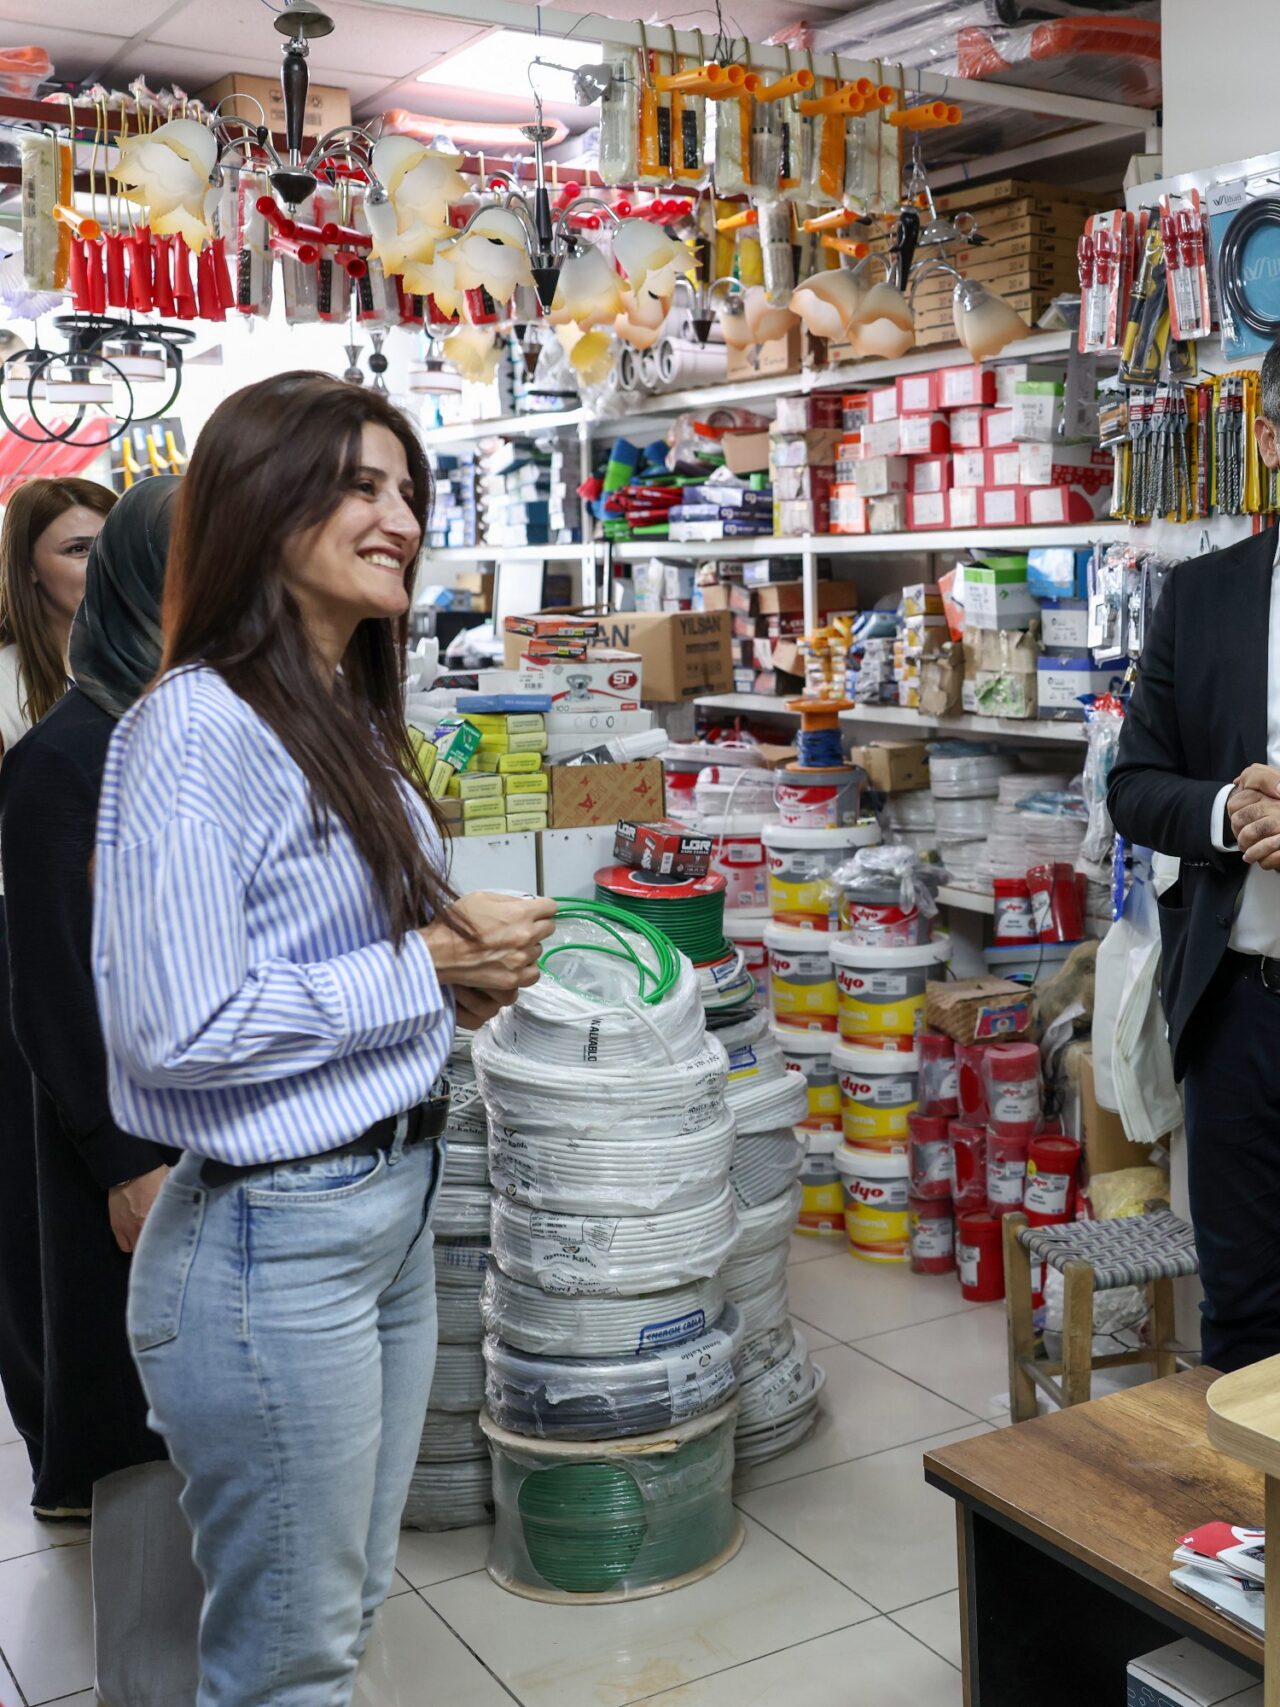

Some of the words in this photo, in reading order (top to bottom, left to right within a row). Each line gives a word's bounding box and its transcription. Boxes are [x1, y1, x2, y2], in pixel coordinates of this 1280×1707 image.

[613, 672, 632, 685] ST
[556, 704, 570, 713] 100
[838, 972, 864, 990] dyo
[842, 1076, 871, 1095] dyo
[850, 1182, 884, 1200] dyo
